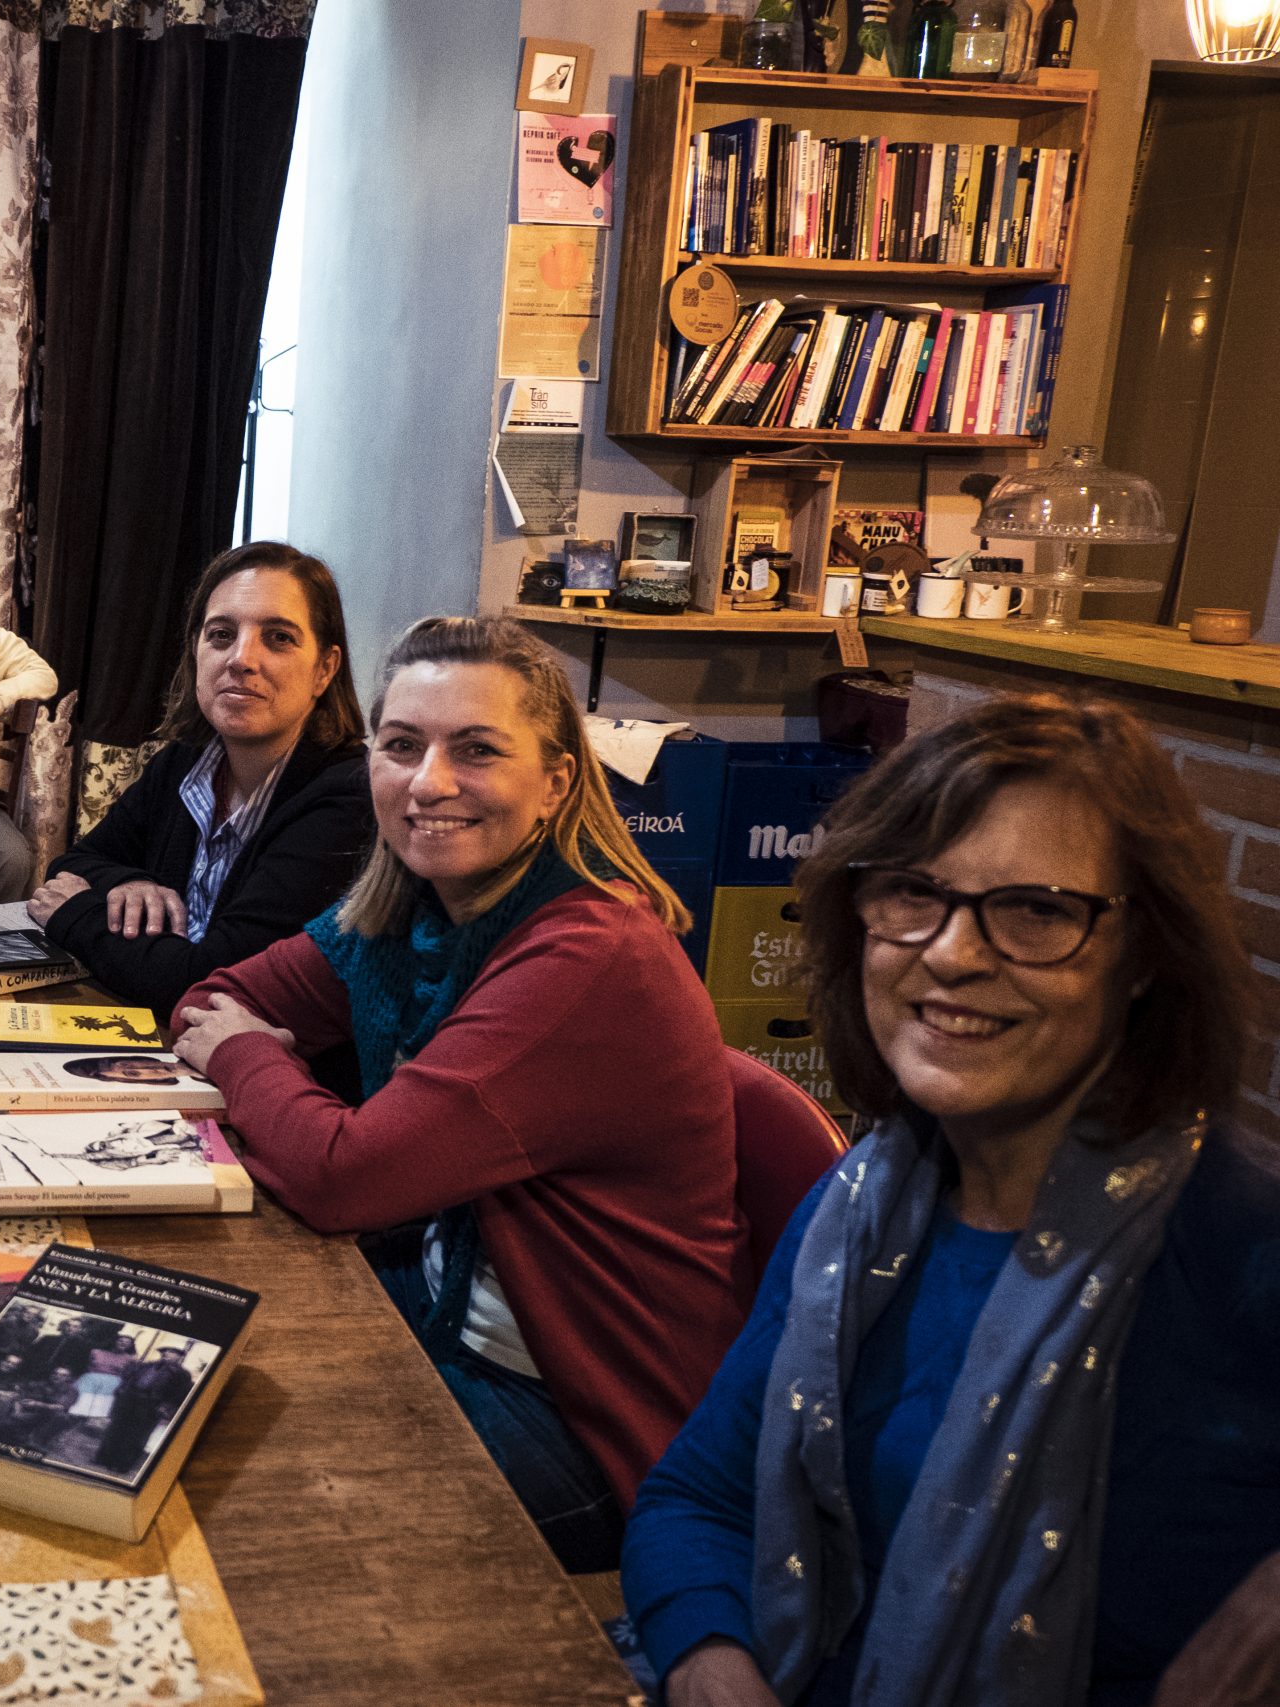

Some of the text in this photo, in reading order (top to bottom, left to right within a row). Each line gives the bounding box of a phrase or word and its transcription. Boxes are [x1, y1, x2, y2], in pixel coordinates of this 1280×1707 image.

[861, 525, 901, 538] MANU
[622, 811, 685, 833] EIROÁ
[110, 1095, 135, 1105] palabra
[14, 1192, 40, 1202] Savage
[42, 1192, 50, 1200] El
[50, 1192, 82, 1200] lamento
[83, 1192, 96, 1200] del
[96, 1192, 130, 1202] perezoso
[37, 1263, 181, 1304] Almudena Grandes
[73, 1285, 87, 1296] Y
[88, 1287, 110, 1301] LA
[114, 1293, 193, 1322] ALEGRÍA
